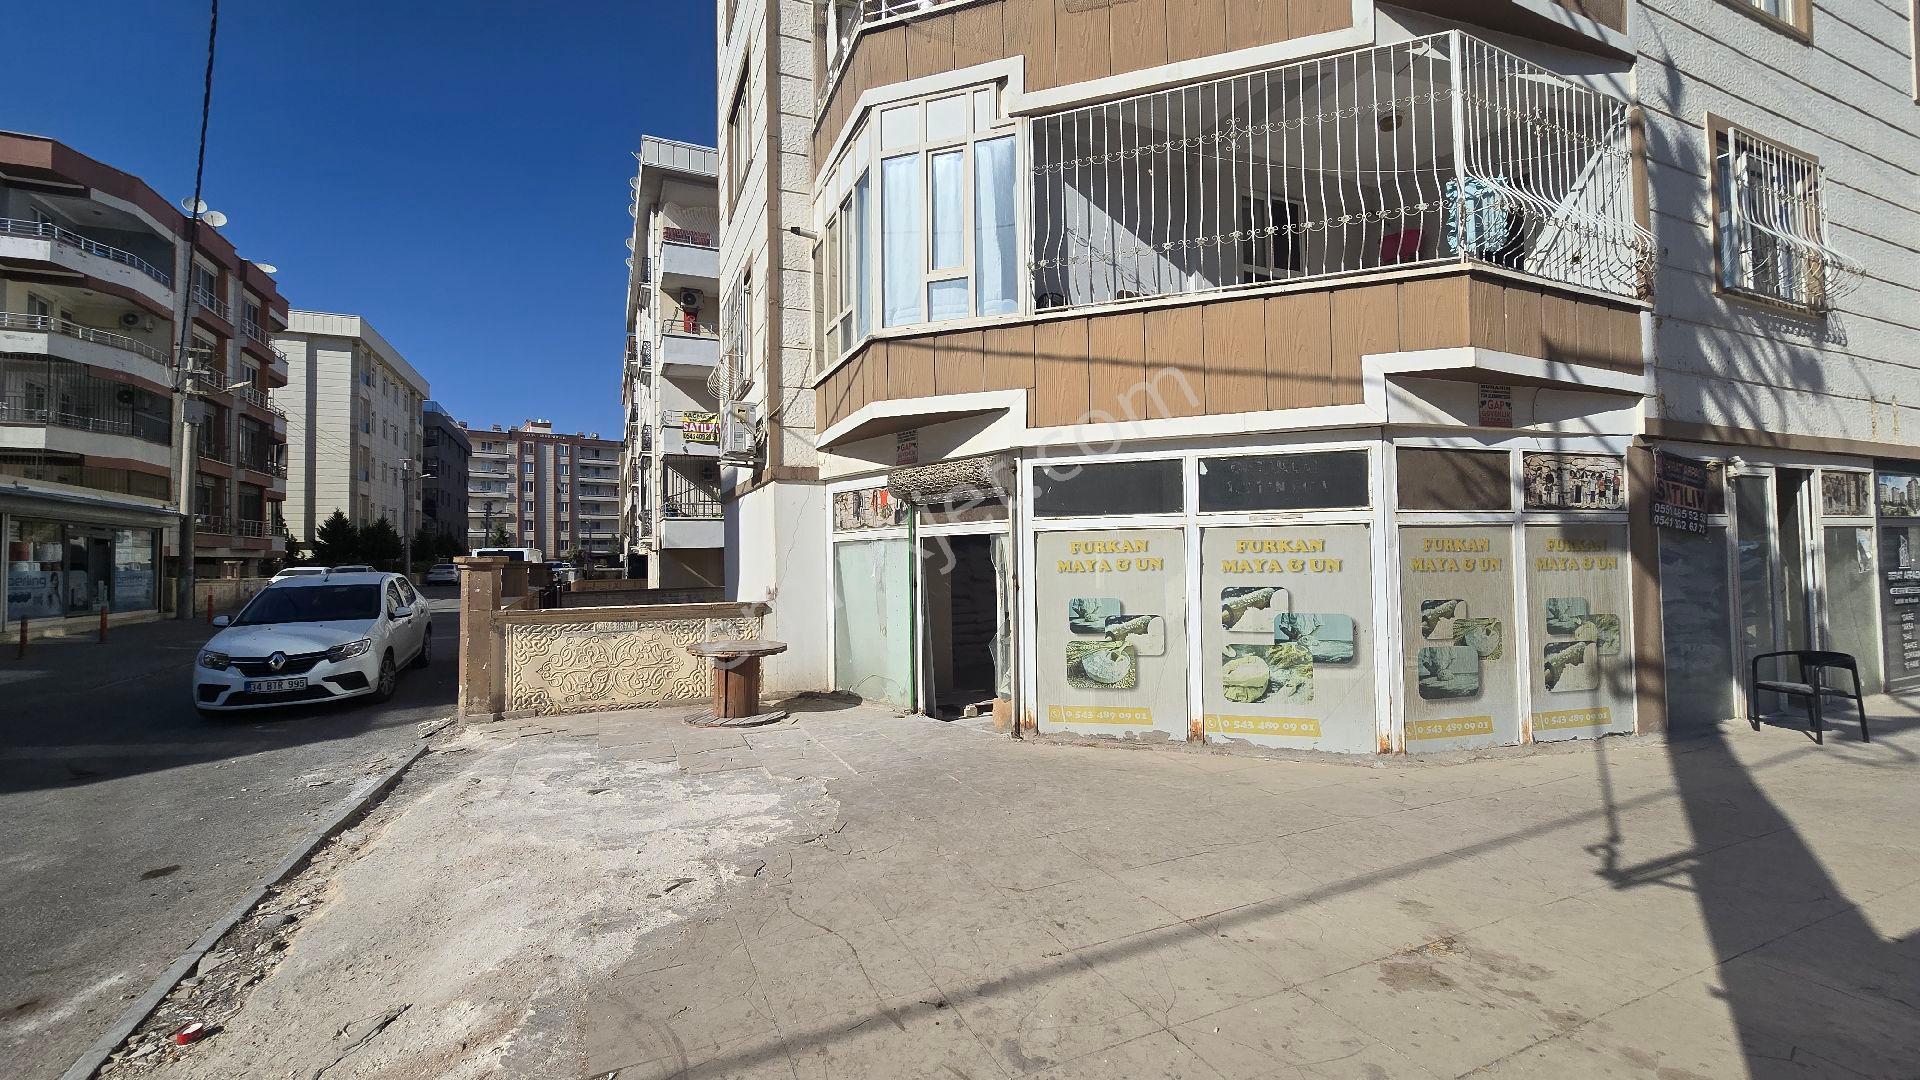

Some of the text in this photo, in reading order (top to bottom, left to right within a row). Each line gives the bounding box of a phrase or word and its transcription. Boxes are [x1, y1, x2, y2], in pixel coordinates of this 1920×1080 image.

[1487, 400, 1505, 410] GAP
[1070, 539, 1149, 554] FURKAN
[1235, 538, 1325, 553] FURKAN
[1423, 538, 1489, 552] FURKAN
[1546, 539, 1606, 552] FURKAN
[1057, 557, 1164, 573] MAYA & UN
[1221, 558, 1342, 573] MAYA & UN
[1409, 557, 1502, 571] MAYA & UN
[1535, 556, 1617, 571] MAYA & UN
[251, 679, 305, 692] 34 BTR 995
[1075, 711, 1093, 719] 543
[1097, 711, 1116, 720] 489
[1118, 712, 1131, 720] 09
[1551, 715, 1567, 725] 543
[1233, 720, 1255, 730] 543
[1258, 721, 1280, 731] 489
[1282, 722, 1297, 731] 09
[1427, 724, 1443, 735] 543
[1446, 722, 1462, 732] 489
[1464, 722, 1475, 731] 09
